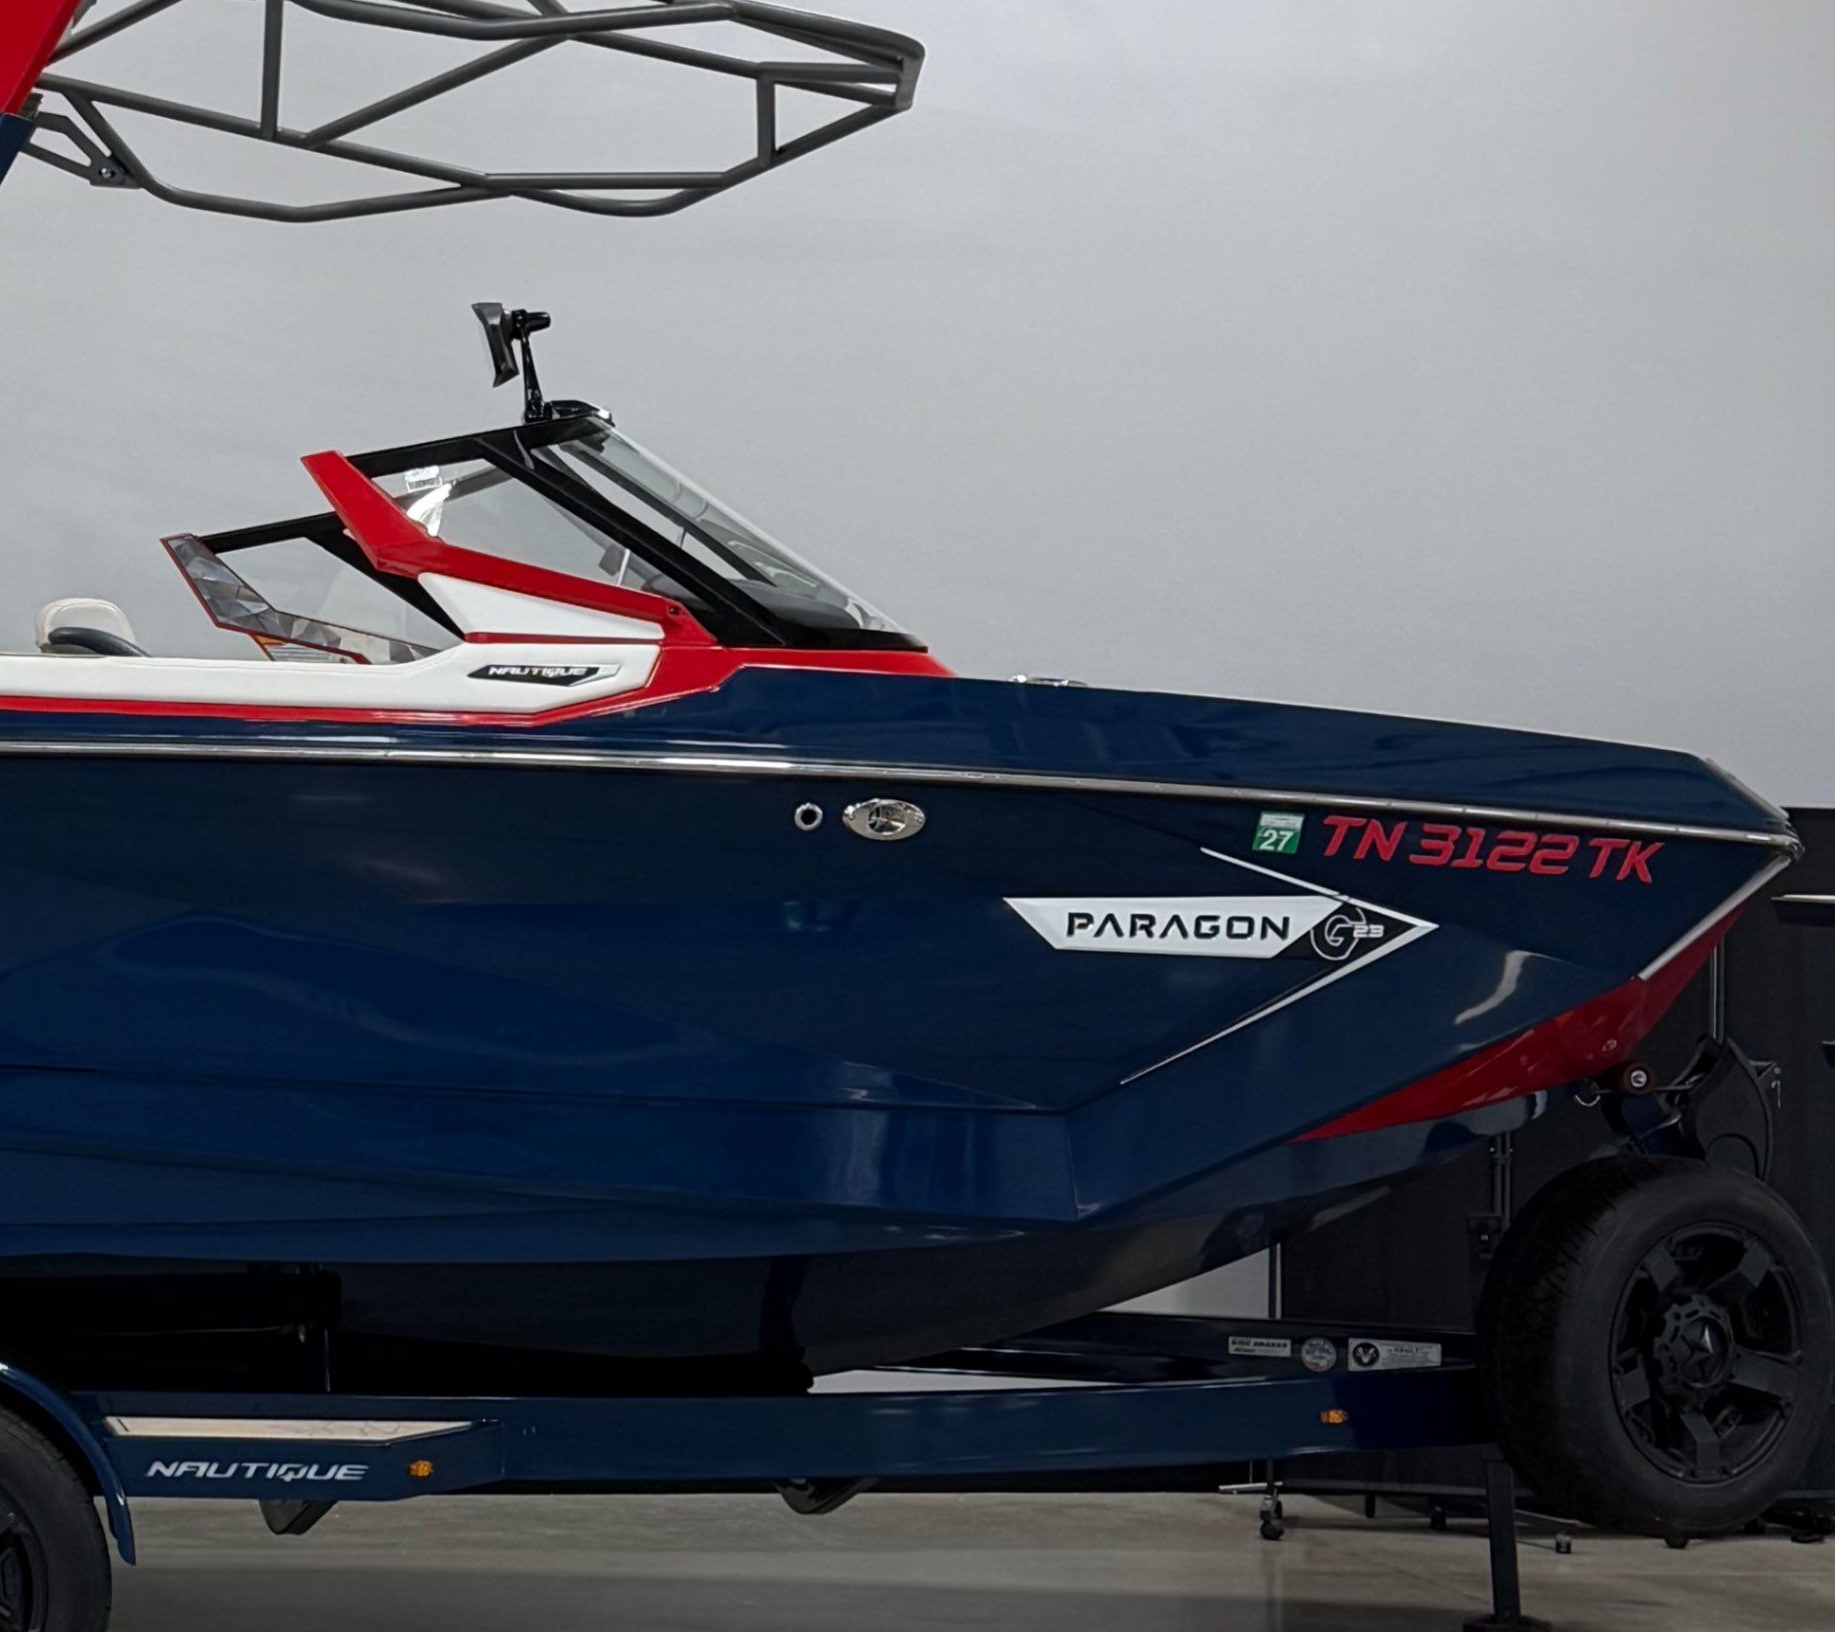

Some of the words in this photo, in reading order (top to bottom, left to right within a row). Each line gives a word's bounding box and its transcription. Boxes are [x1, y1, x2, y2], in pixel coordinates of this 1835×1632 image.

[487, 665, 588, 679] NAUTIQUE
[1258, 828, 1294, 852] 27
[1323, 814, 1408, 862] TN
[1408, 822, 1580, 876] 3122
[1588, 837, 1665, 884] TK
[1066, 911, 1291, 942] PARAGON
[145, 1460, 369, 1482] NAUTIQUE
